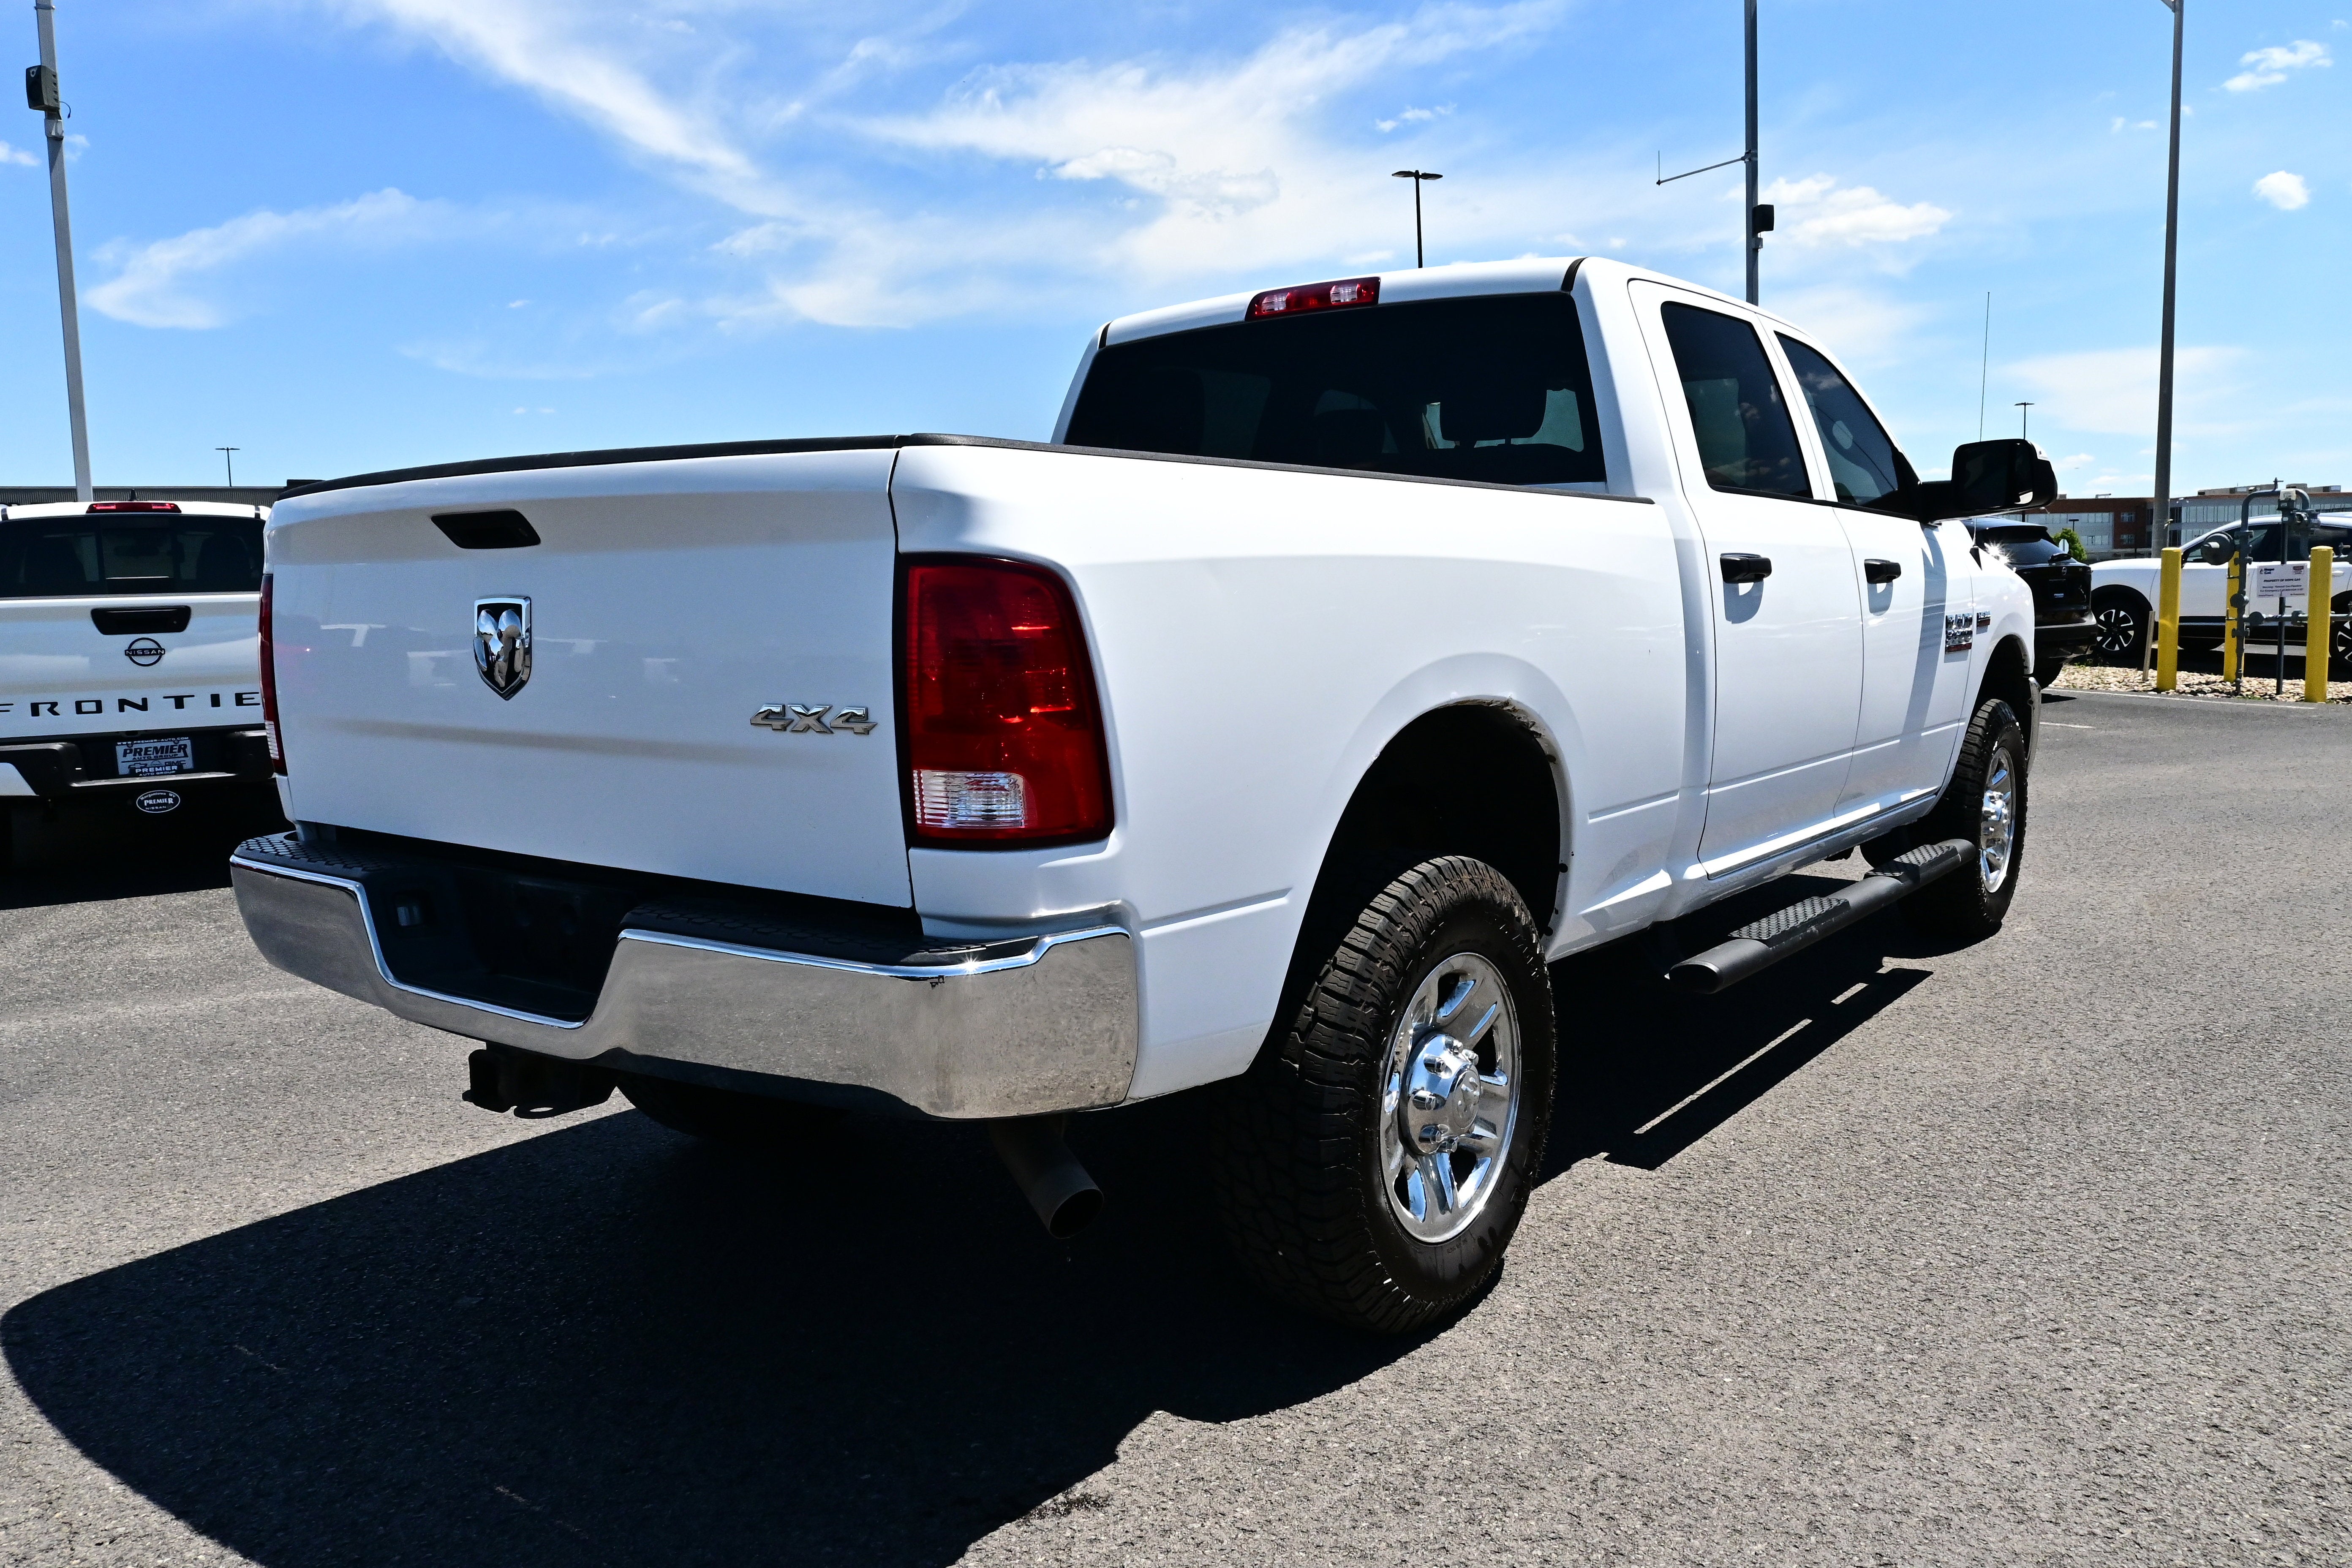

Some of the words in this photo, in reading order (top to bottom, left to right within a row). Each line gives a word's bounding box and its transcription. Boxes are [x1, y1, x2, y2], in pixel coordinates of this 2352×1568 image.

[122, 744, 188, 757] PREMIER
[140, 792, 166, 800] Morgantown
[144, 798, 174, 806] PREMIER
